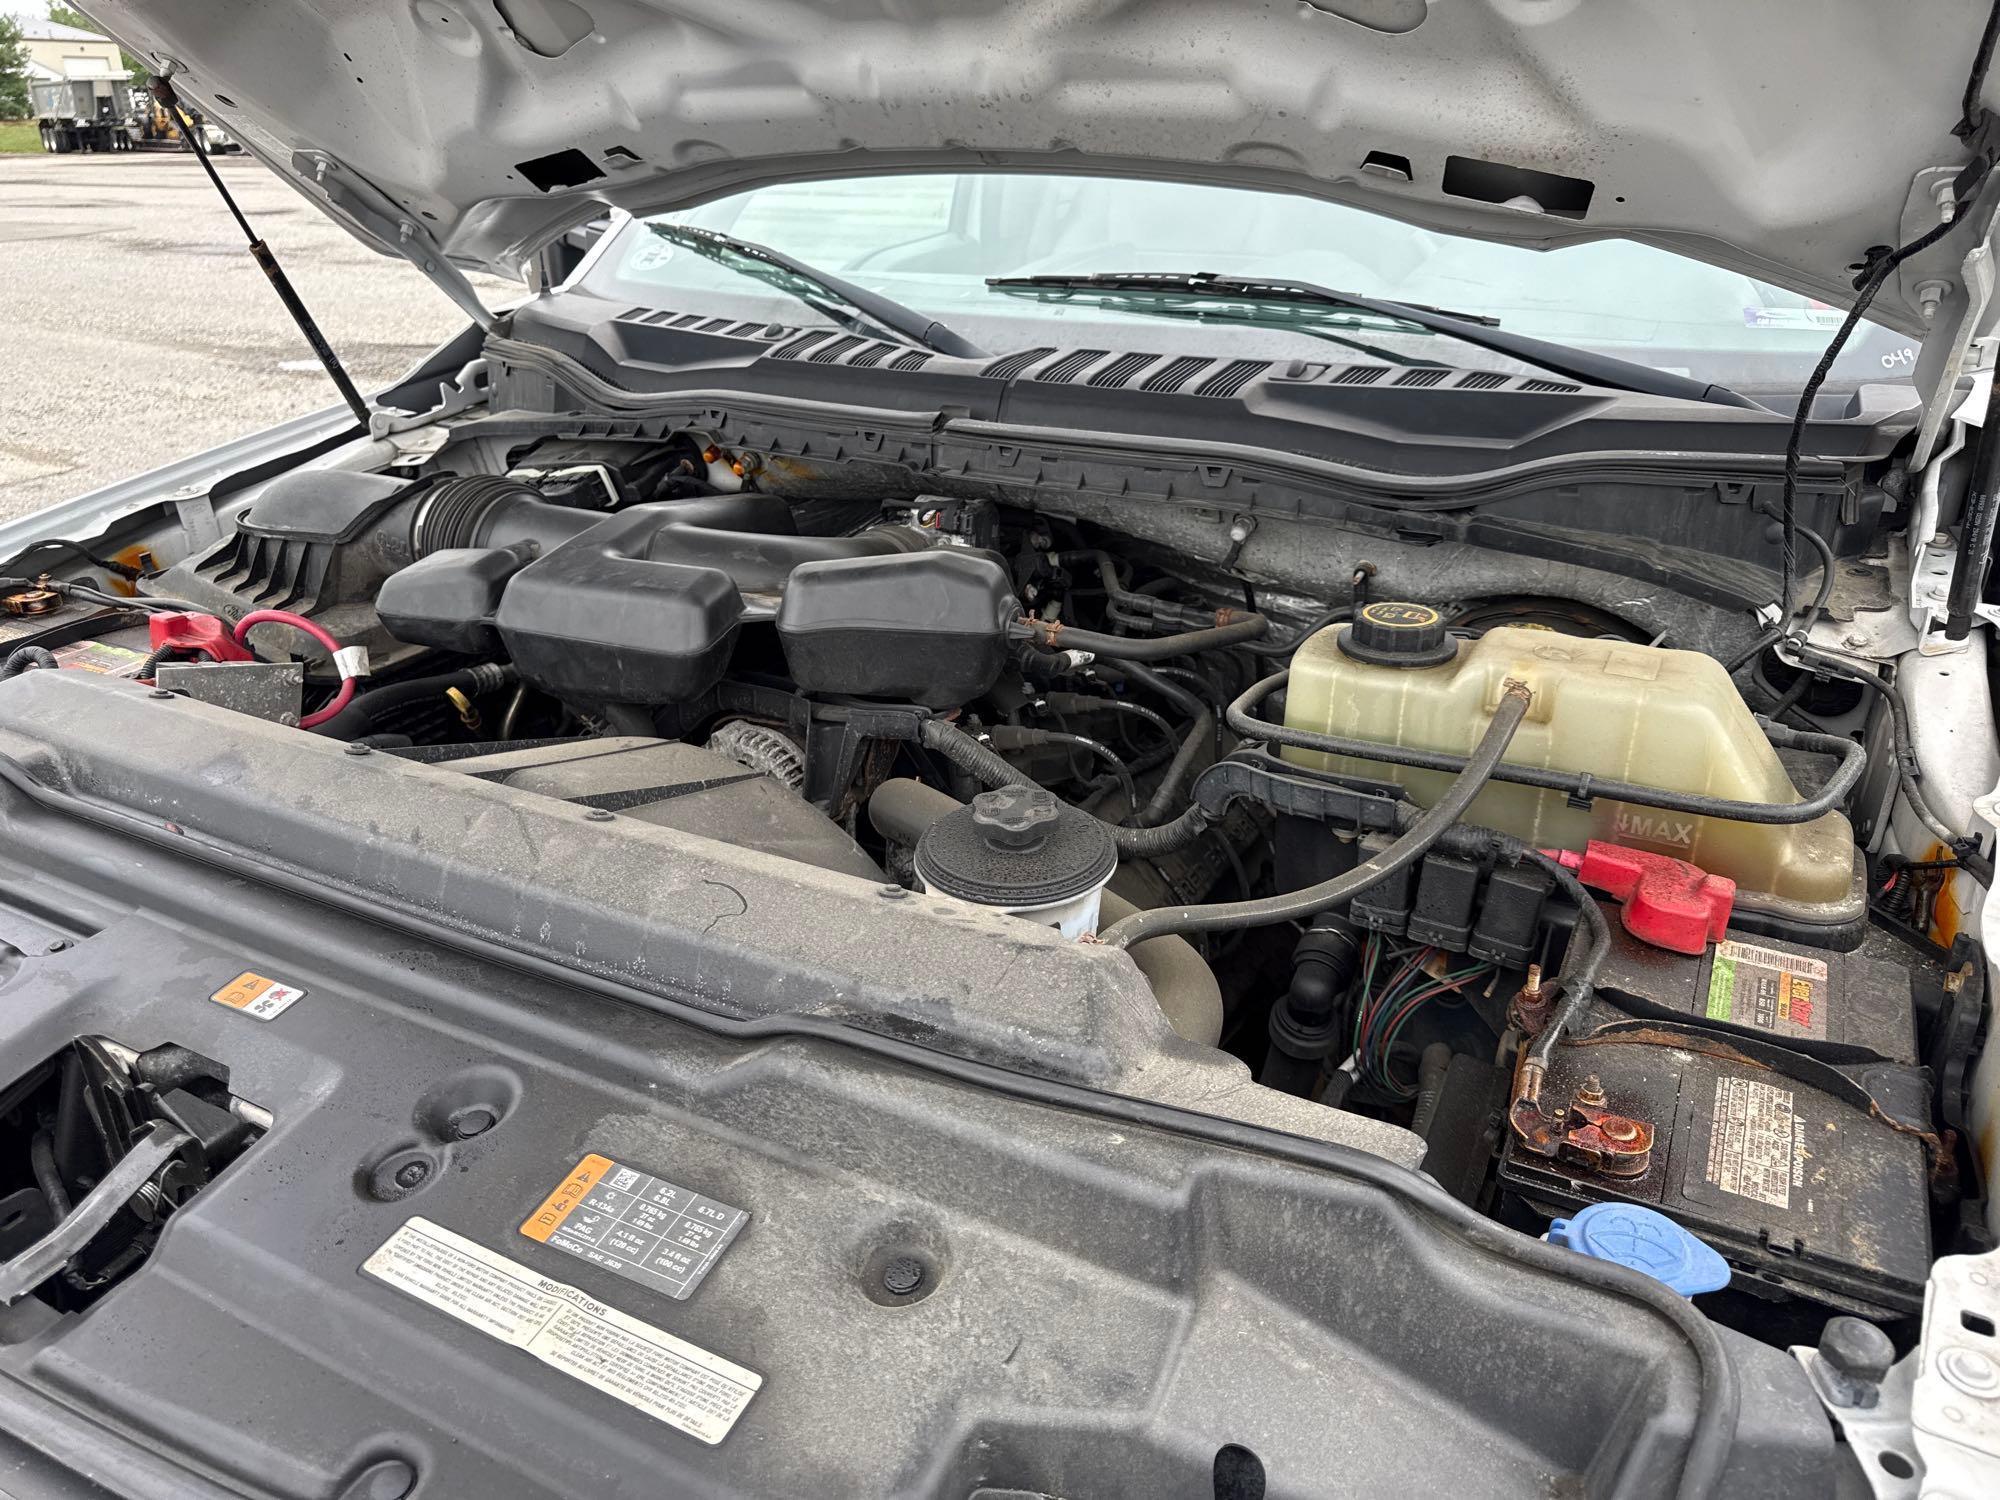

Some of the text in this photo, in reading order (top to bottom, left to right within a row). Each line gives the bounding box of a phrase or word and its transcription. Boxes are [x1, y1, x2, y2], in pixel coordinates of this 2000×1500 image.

[1881, 348, 1914, 369] 049
[1631, 815, 1693, 844] MAX
[658, 1187, 679, 1198] 6.2L
[587, 1198, 616, 1213] R-134a
[696, 1206, 717, 1218] 6.7L
[655, 1211, 667, 1220] kg
[573, 1223, 593, 1234] PAG
[700, 1228, 714, 1238] kg
[549, 1235, 584, 1254] FoMoCo
[586, 1251, 604, 1262] SAE
[608, 1238, 640, 1255] (120 cc)
[654, 1257, 686, 1274] (100 cc)
[537, 1278, 608, 1317] MODIFICATIONS
